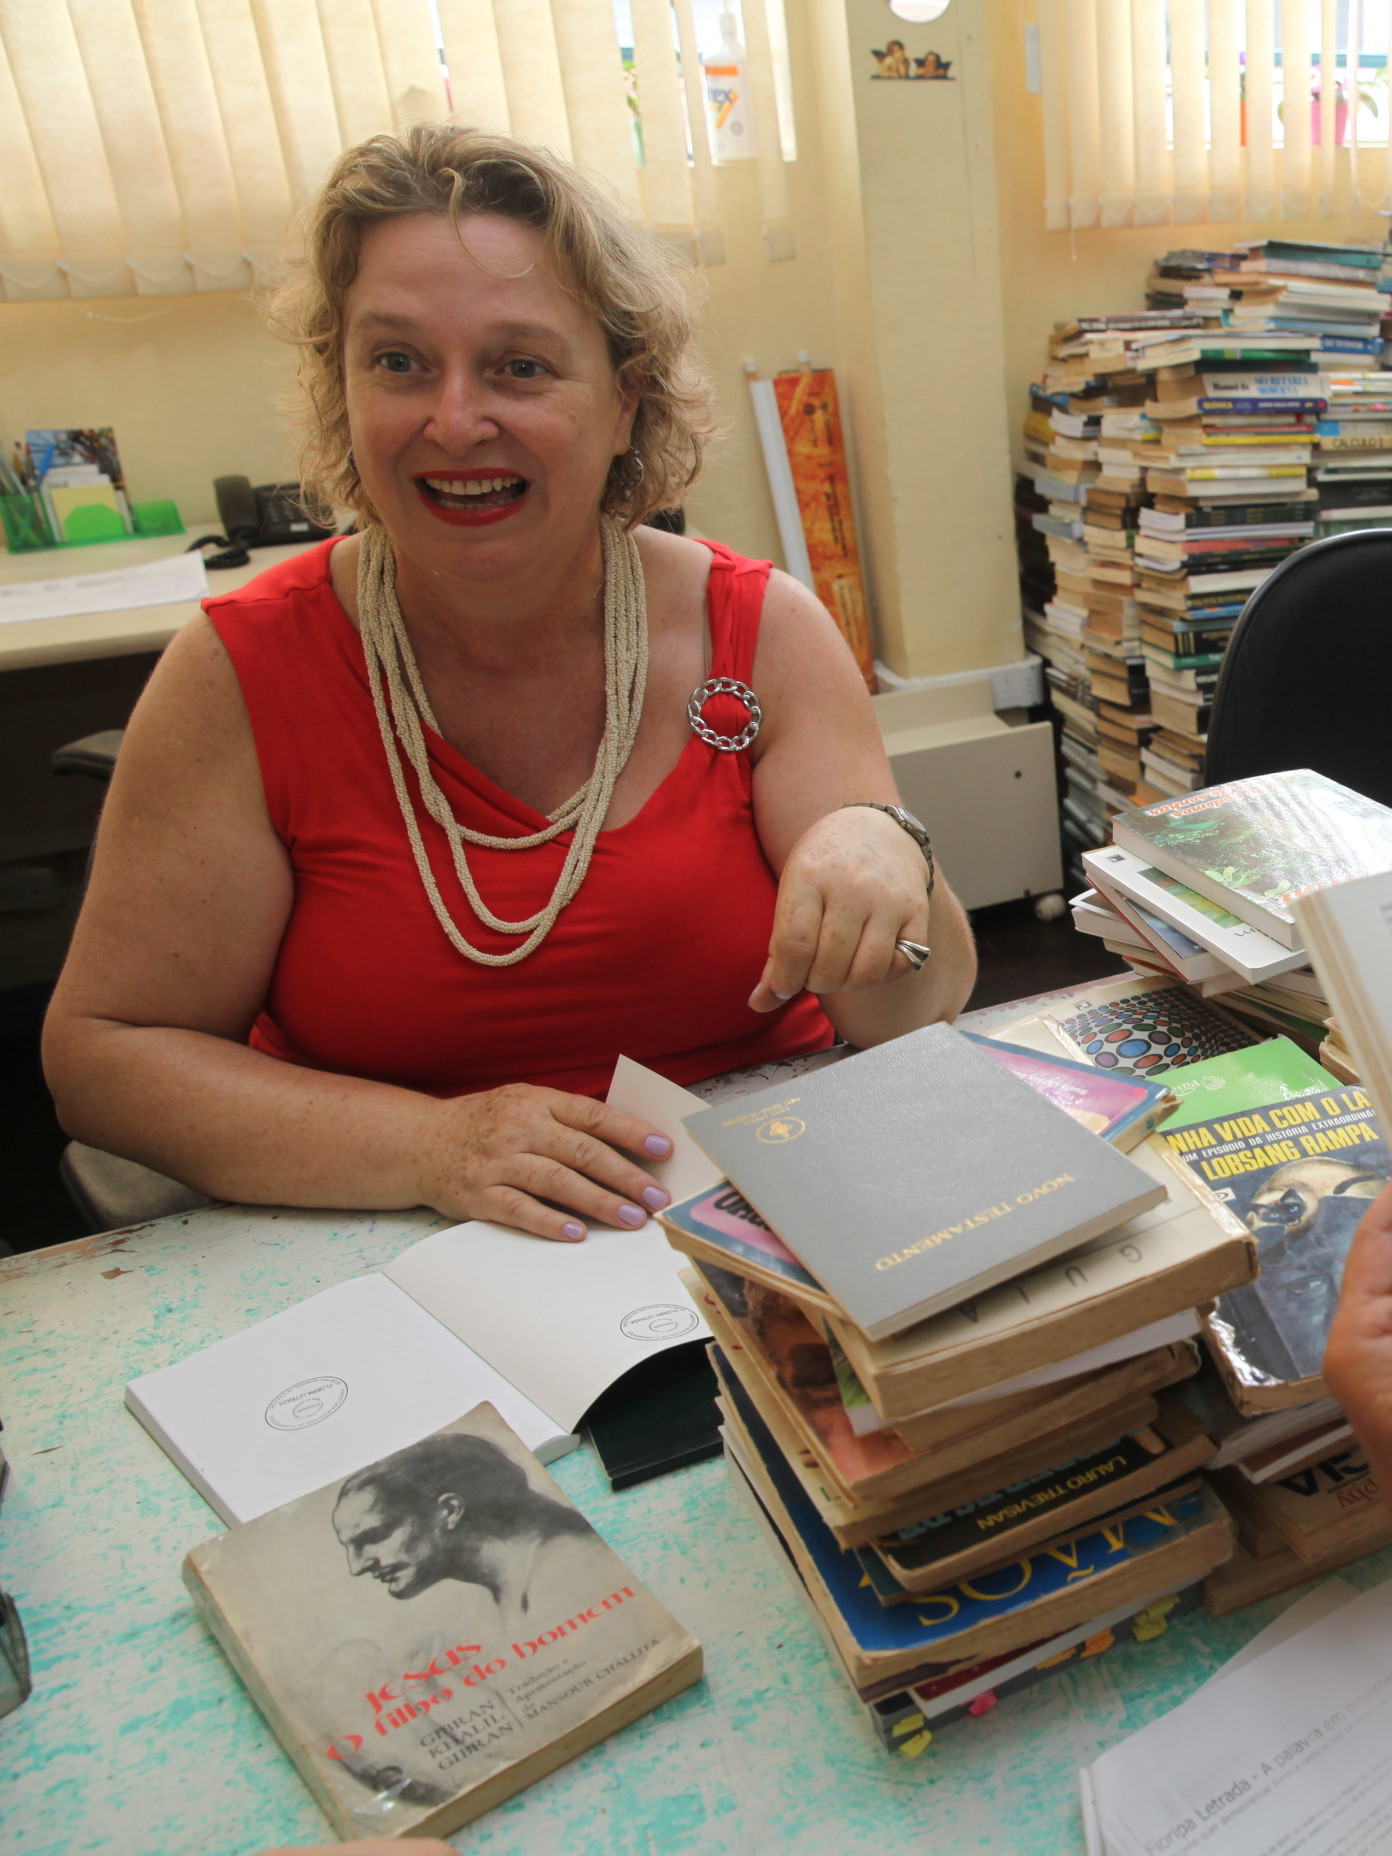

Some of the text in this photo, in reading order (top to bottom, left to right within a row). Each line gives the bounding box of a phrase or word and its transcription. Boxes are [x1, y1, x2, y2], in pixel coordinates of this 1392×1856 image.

[1166, 1089, 1374, 1155] NHA VIDA COM O LA
[1181, 1107, 1376, 1164] UM EPISÓDIO DA HISTÓRIA EXTRAORDINÁ
[1200, 1121, 1380, 1182] LOBSANG RAMPA
[874, 1171, 1077, 1272] NOVO TESTAMENTO
[1066, 1454, 1128, 1491] LAURO
[1336, 1478, 1381, 1509] phy
[976, 1483, 1069, 1531] TREVISAN
[462, 1658, 507, 1688] do
[511, 1585, 635, 1660] homem
[506, 1662, 562, 1696] Tradução
[525, 1638, 662, 1722] MANSOUR CHALLITA
[419, 1699, 497, 1748] GIBRAN
[438, 1722, 514, 1772] GIBRAN
[1144, 1816, 1198, 1856] Floripa
[1194, 1778, 1252, 1823] Letrada
[1260, 1761, 1275, 1777] A
[1272, 1727, 1324, 1770] palavra
[1321, 1710, 1347, 1731] em
